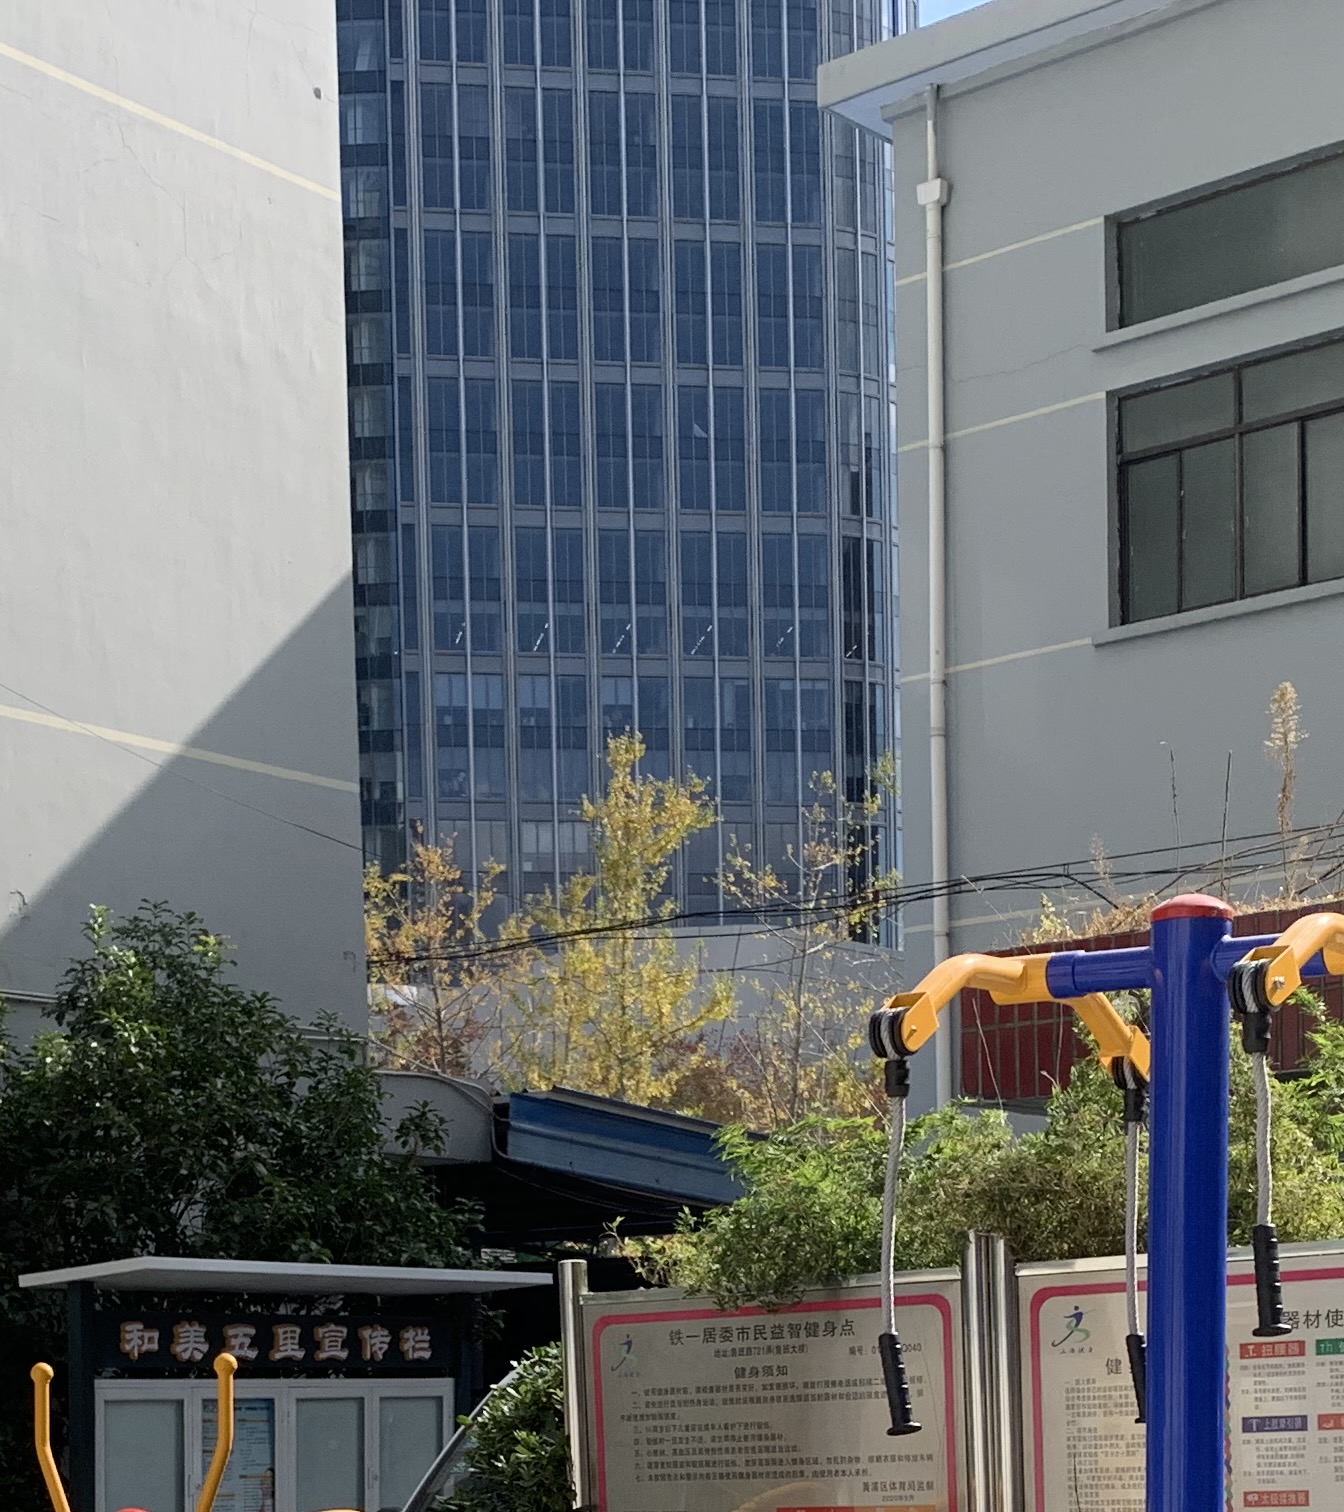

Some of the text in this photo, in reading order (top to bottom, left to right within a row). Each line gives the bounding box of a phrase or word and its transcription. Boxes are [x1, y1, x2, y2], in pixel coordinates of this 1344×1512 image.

[119, 1320, 433, 1362] 和美五里宣传栏
[668, 1318, 857, 1346] 铁一居委市民益智健身点
[734, 1364, 789, 1380] 健身须知
